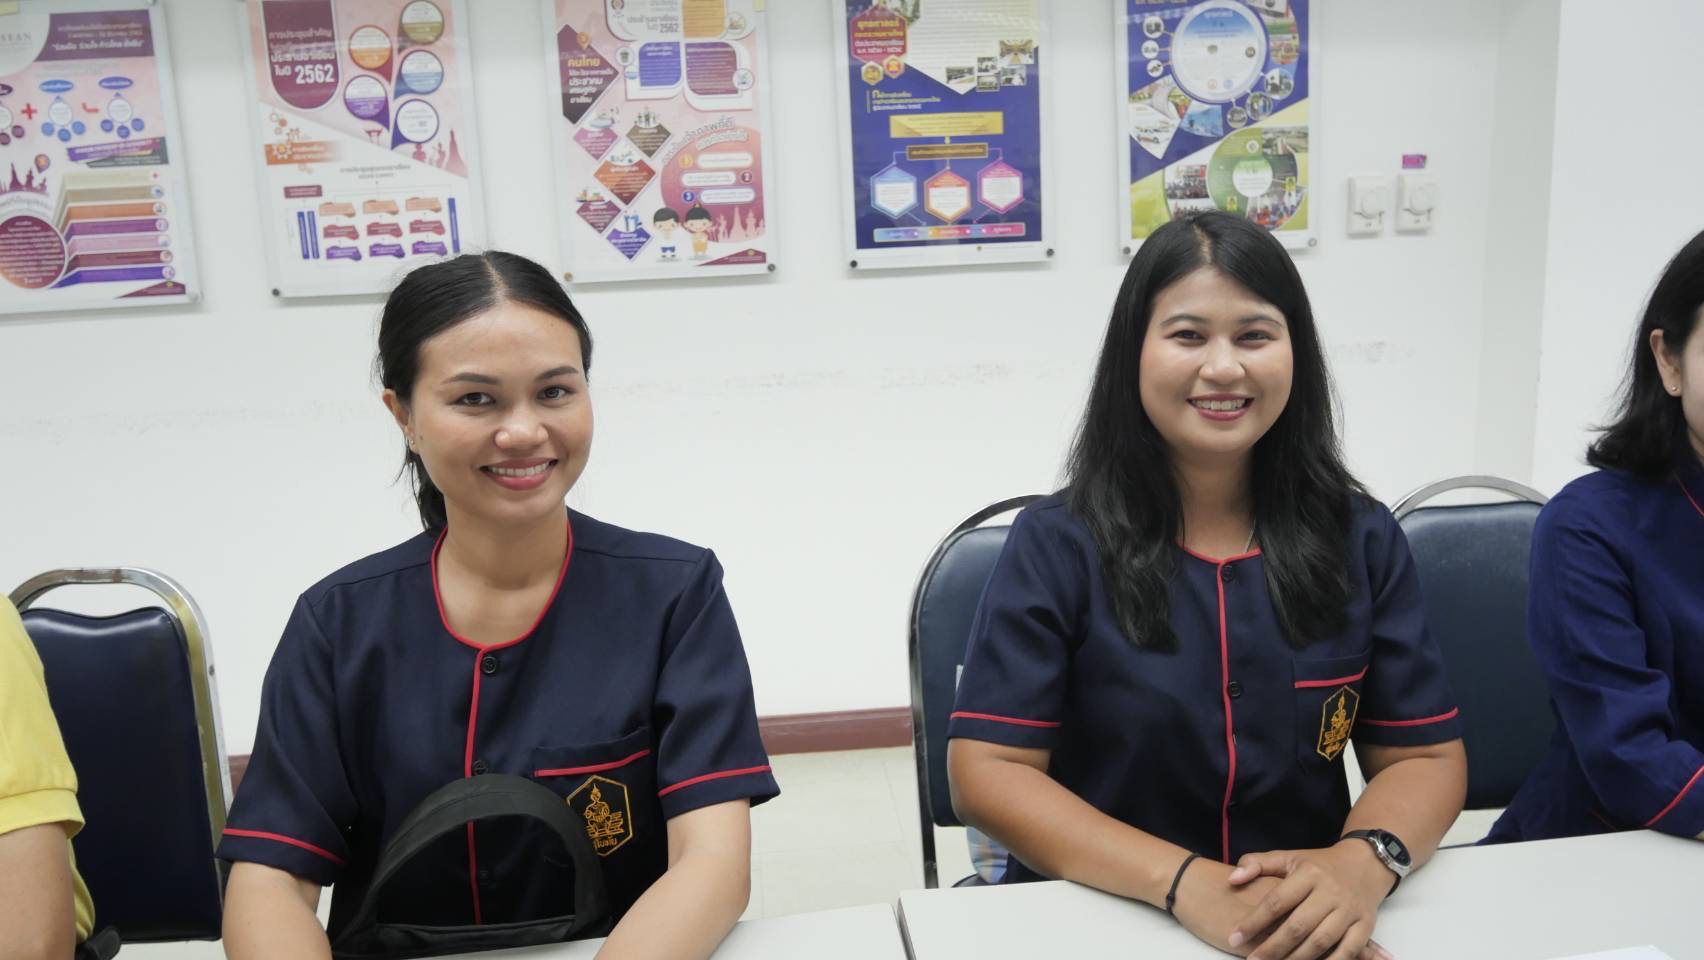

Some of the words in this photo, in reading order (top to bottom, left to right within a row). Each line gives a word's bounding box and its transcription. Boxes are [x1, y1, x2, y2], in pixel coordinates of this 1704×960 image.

[660, 23, 679, 33] 2562
[568, 54, 600, 67] คนไทย
[295, 64, 334, 84] 2562
